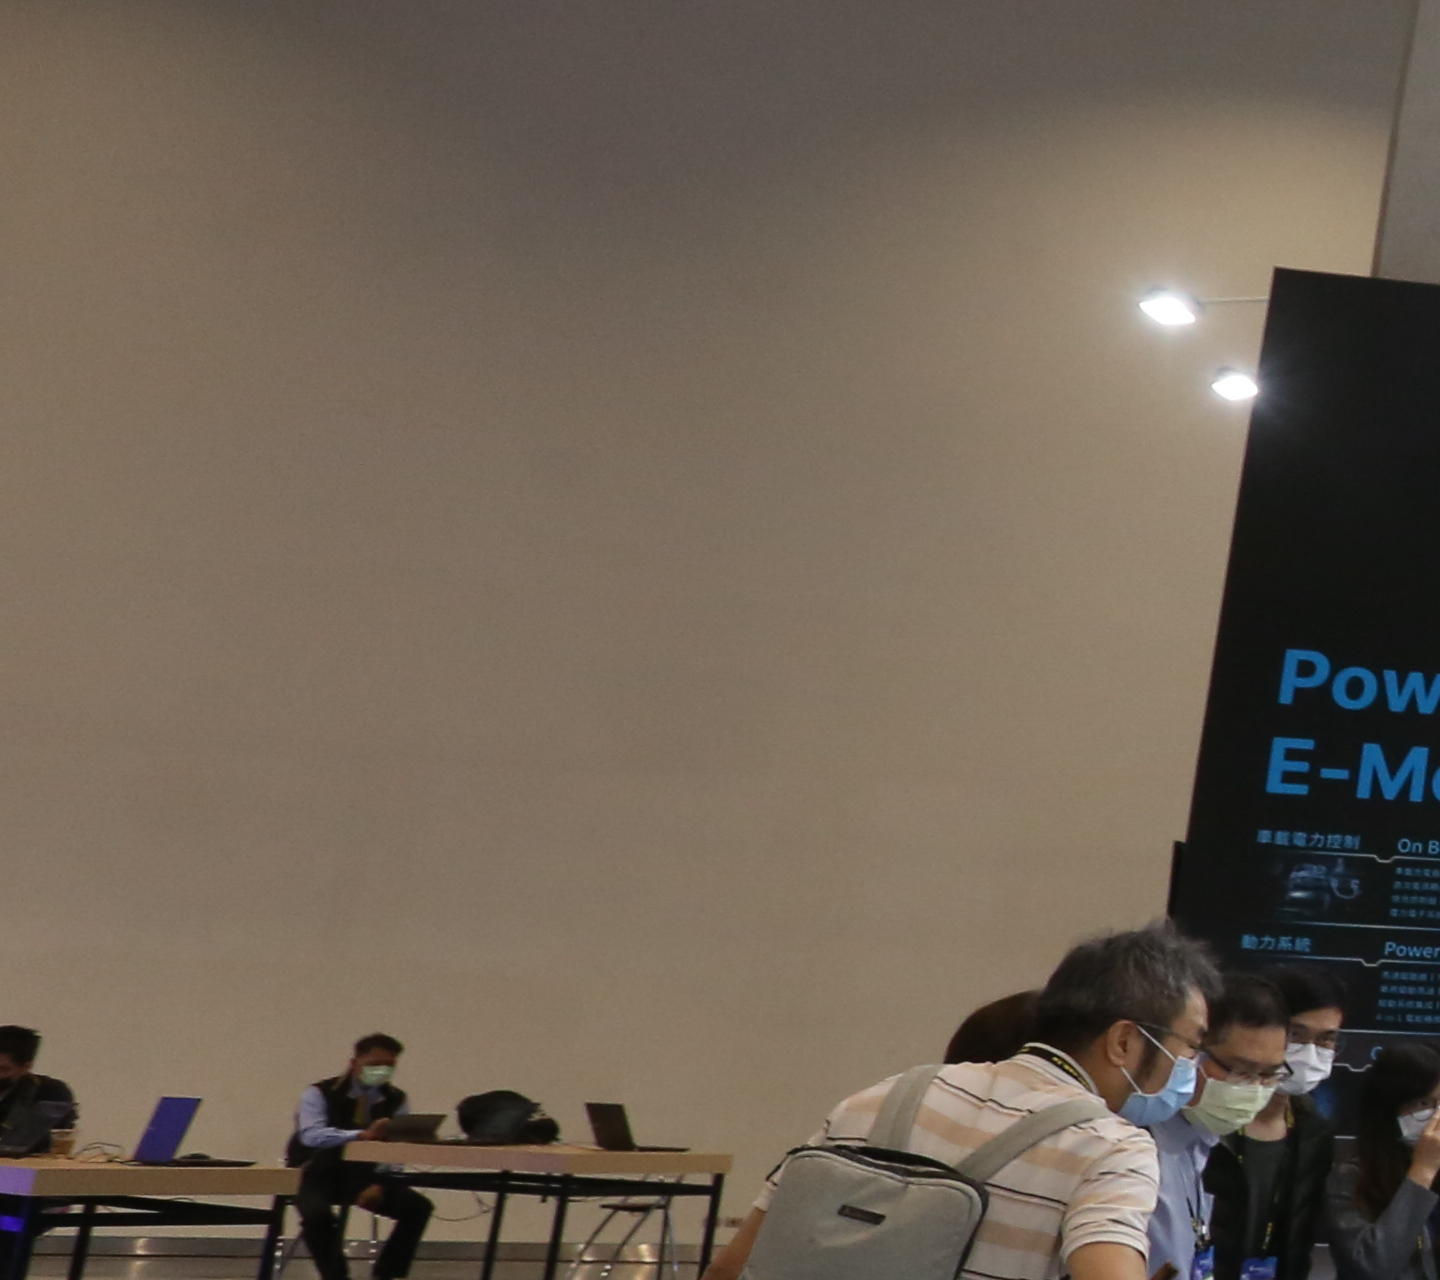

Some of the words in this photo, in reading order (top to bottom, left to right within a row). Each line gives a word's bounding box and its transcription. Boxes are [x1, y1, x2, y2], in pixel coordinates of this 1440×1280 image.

[1397, 838, 1423, 854] On
[1240, 933, 1312, 953] 動力系統
